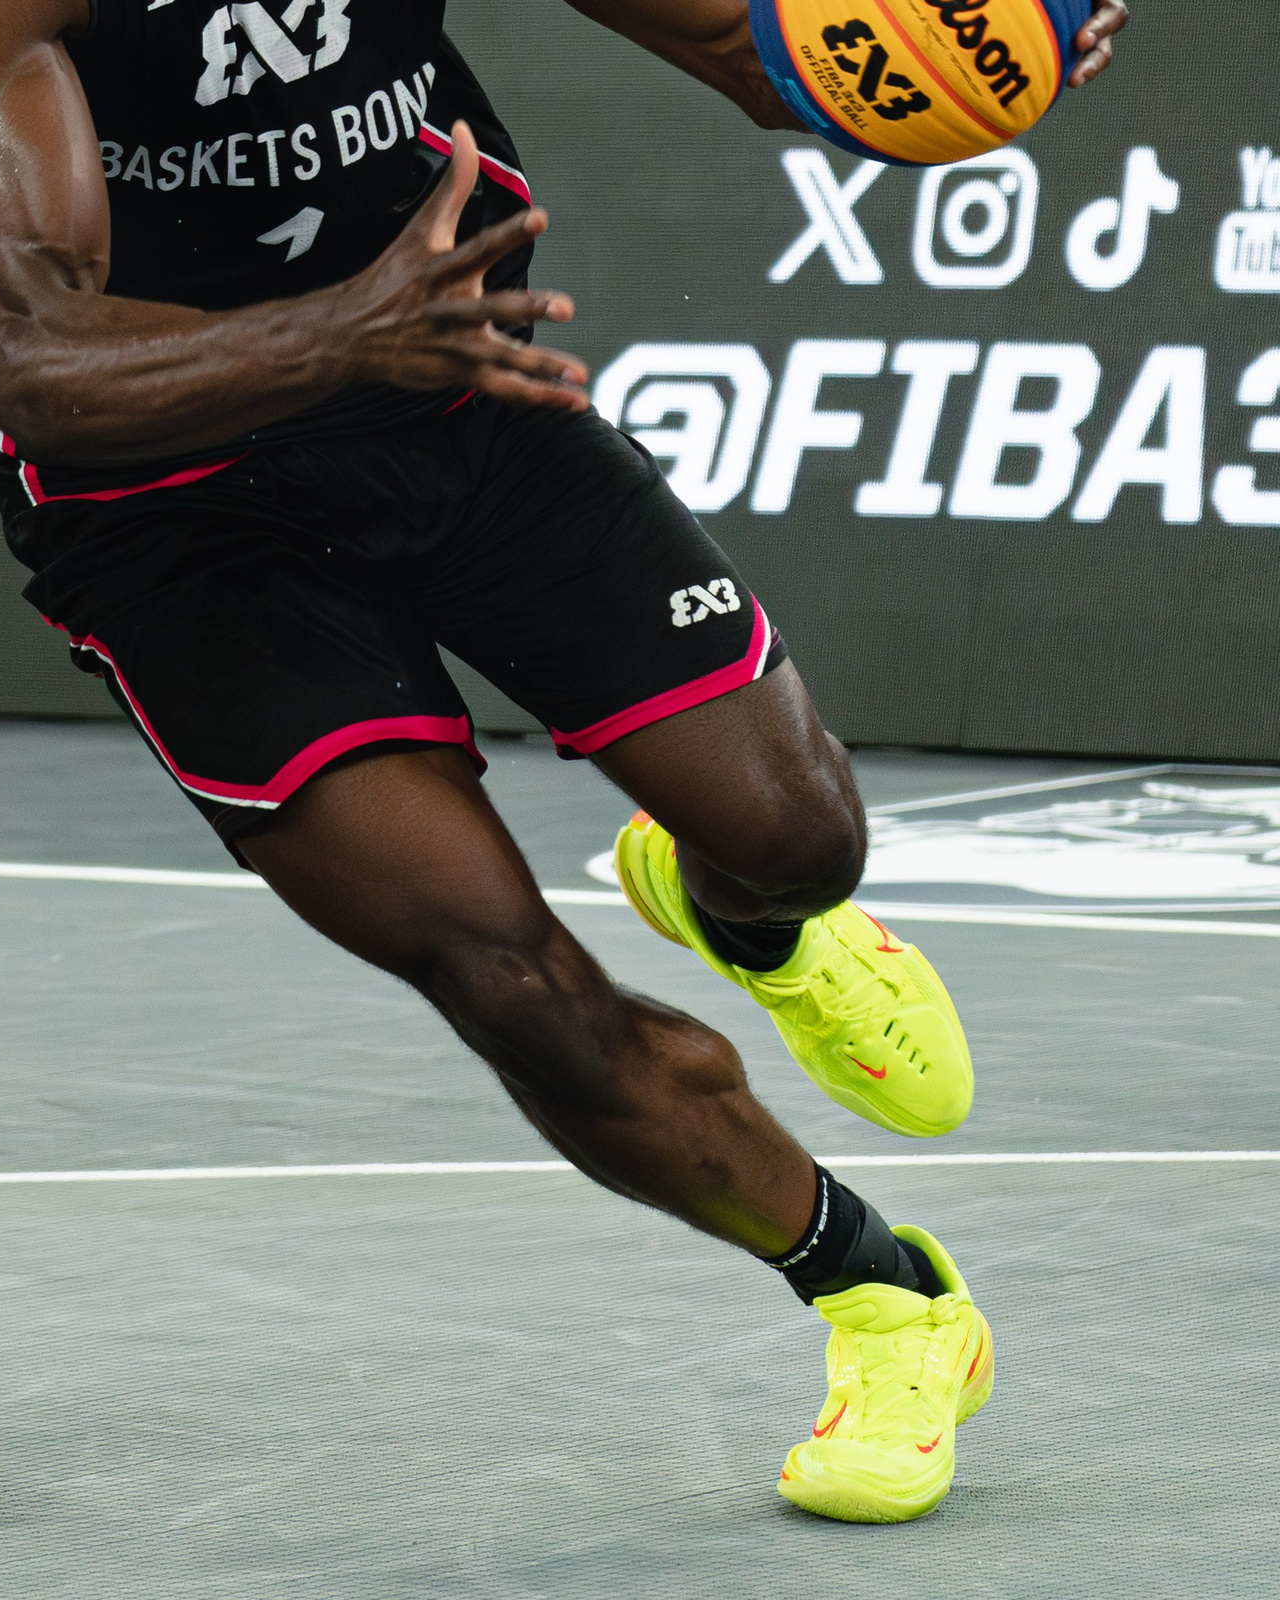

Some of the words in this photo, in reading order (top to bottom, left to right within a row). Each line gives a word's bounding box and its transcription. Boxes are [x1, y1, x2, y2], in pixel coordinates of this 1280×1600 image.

[800, 45, 842, 104] OFFICIAL
[839, 103, 869, 131] BALL
[819, 58, 845, 88] FIBA
[99, 123, 322, 191] BASKETS
